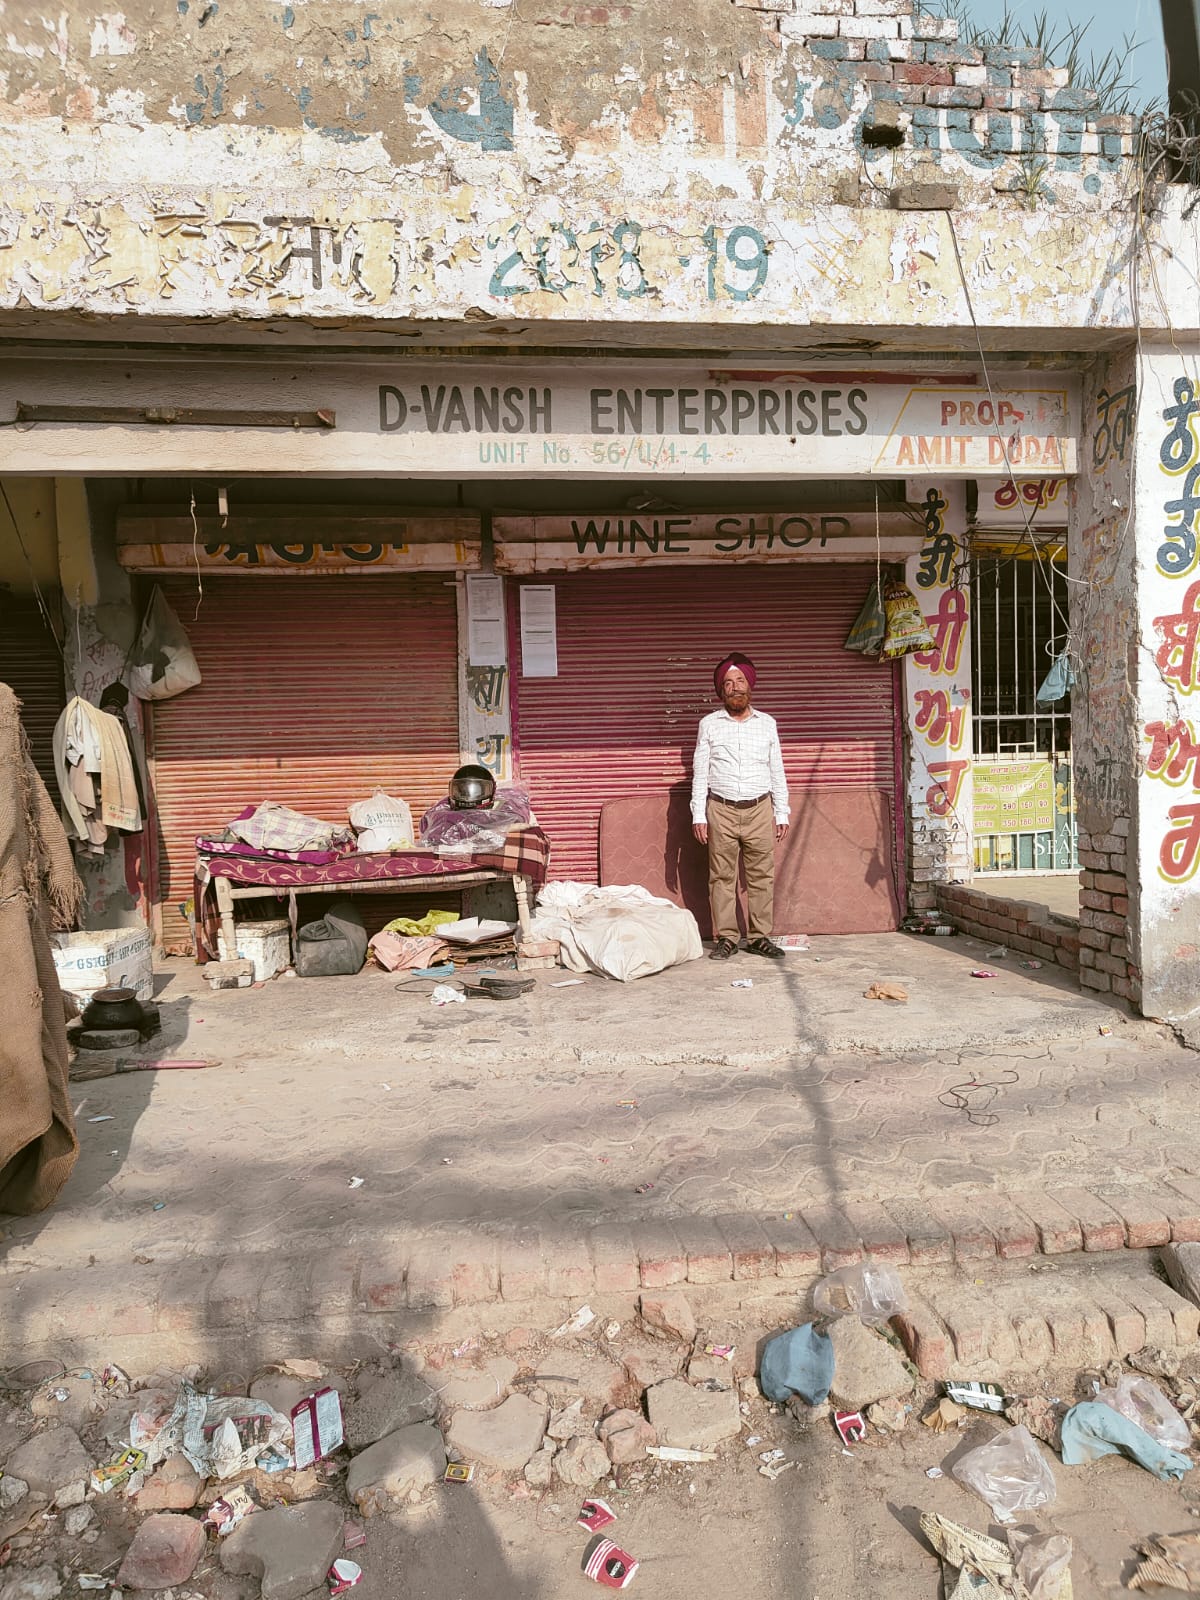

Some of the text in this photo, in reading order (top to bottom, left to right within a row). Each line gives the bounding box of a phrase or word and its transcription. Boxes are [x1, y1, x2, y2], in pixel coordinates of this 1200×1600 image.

[379, 384, 868, 437] D-VANSH ENTERPRISES
[479, 441, 529, 464] UNIT
[543, 441, 578, 464] No.
[896, 435, 973, 465] AMIT
[571, 517, 850, 553] WINE SHOP
